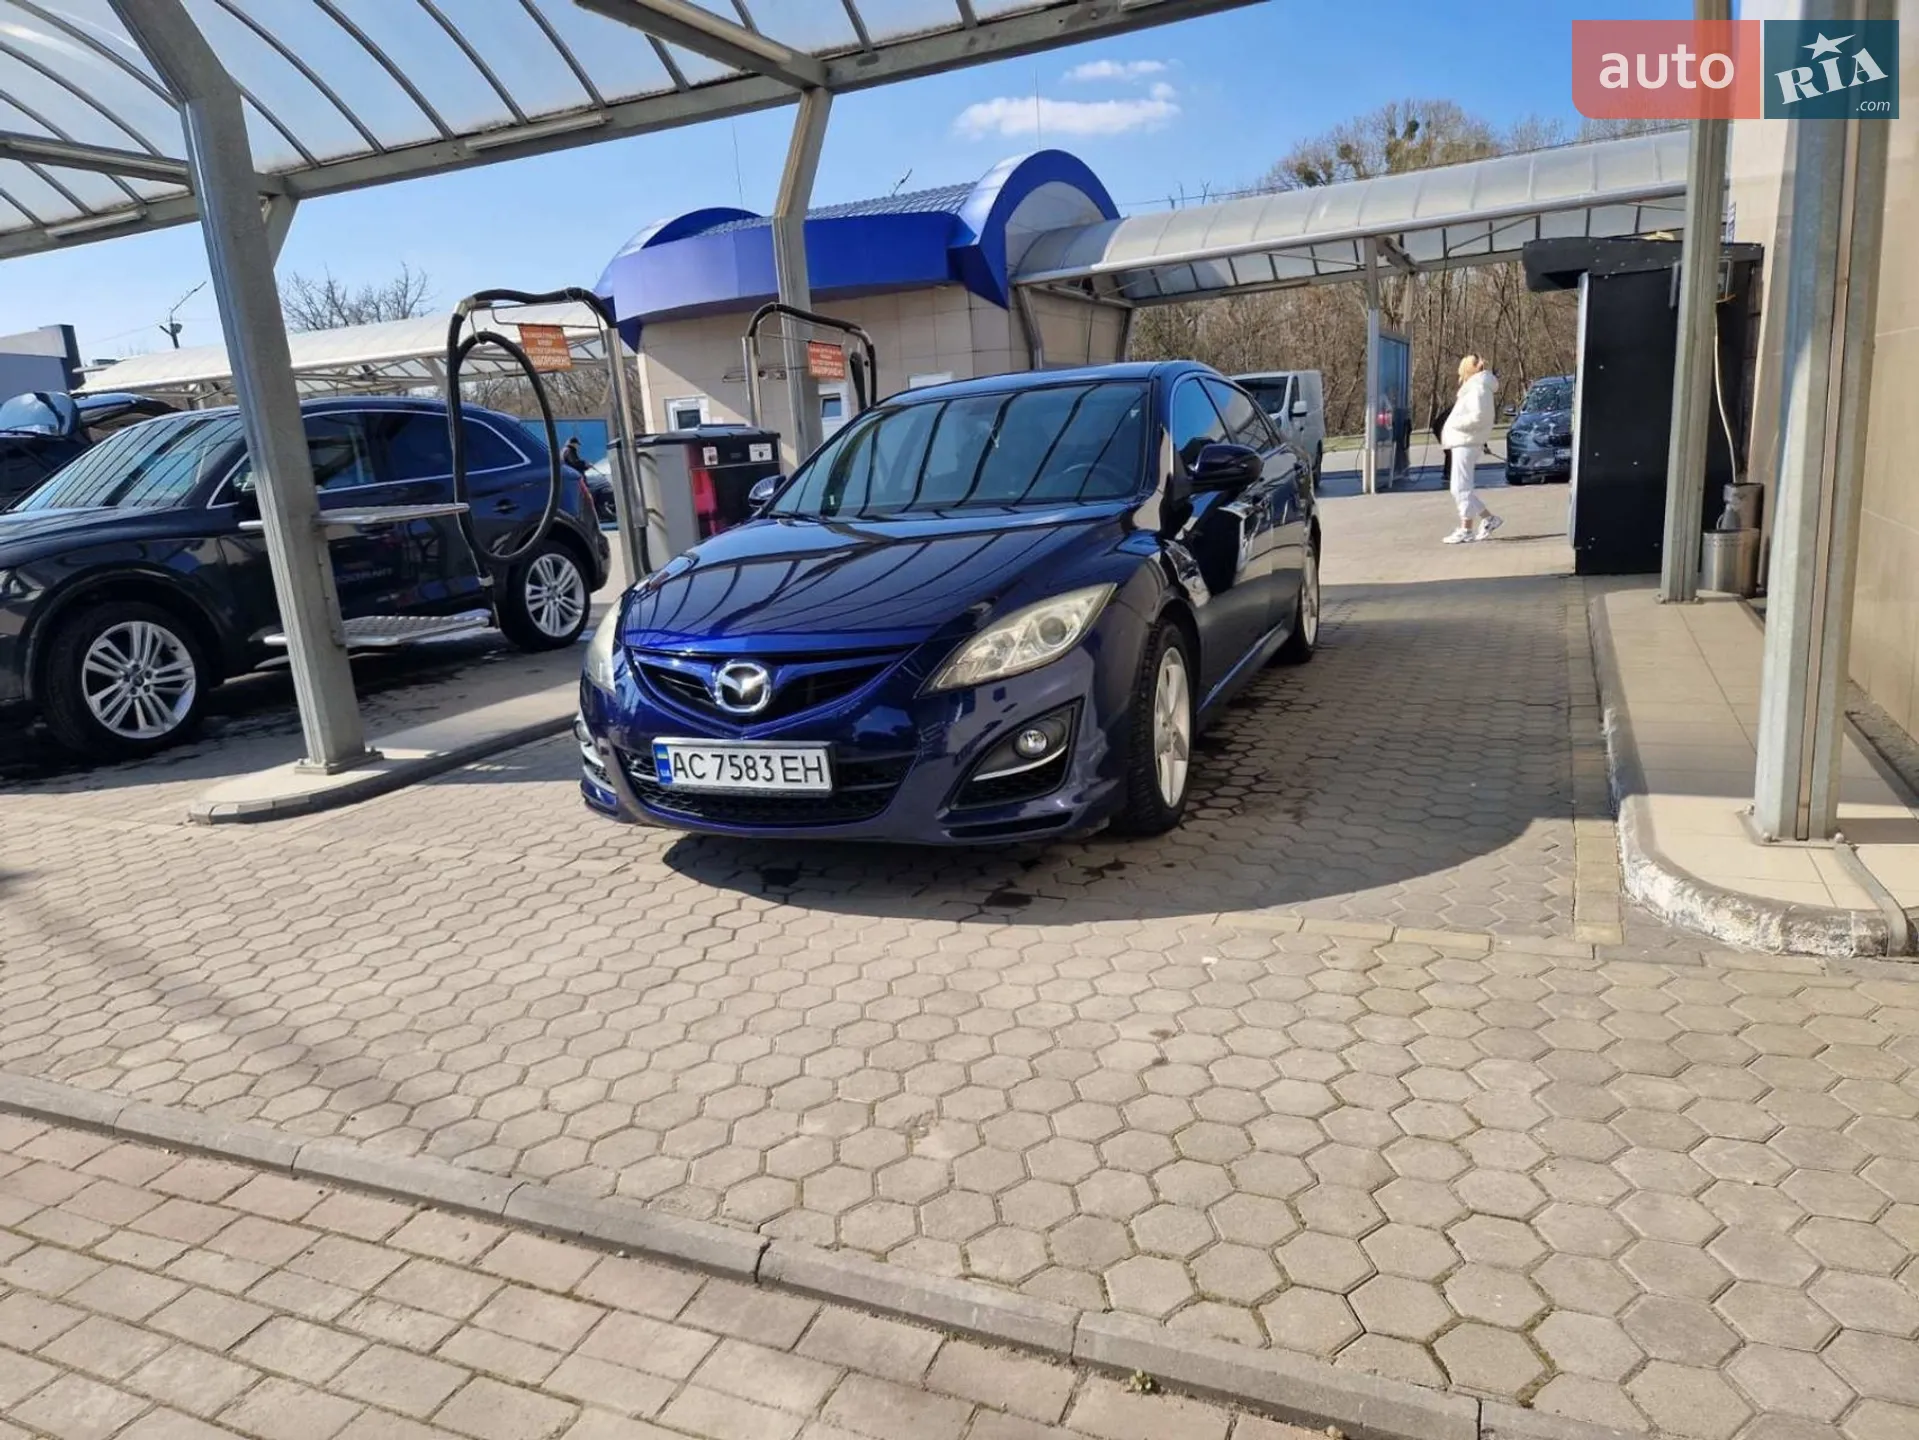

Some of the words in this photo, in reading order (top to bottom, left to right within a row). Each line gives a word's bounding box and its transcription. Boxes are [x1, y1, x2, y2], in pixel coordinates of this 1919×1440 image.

[673, 752, 706, 779] AC
[711, 754, 775, 782] 7583
[780, 755, 824, 783] EH
